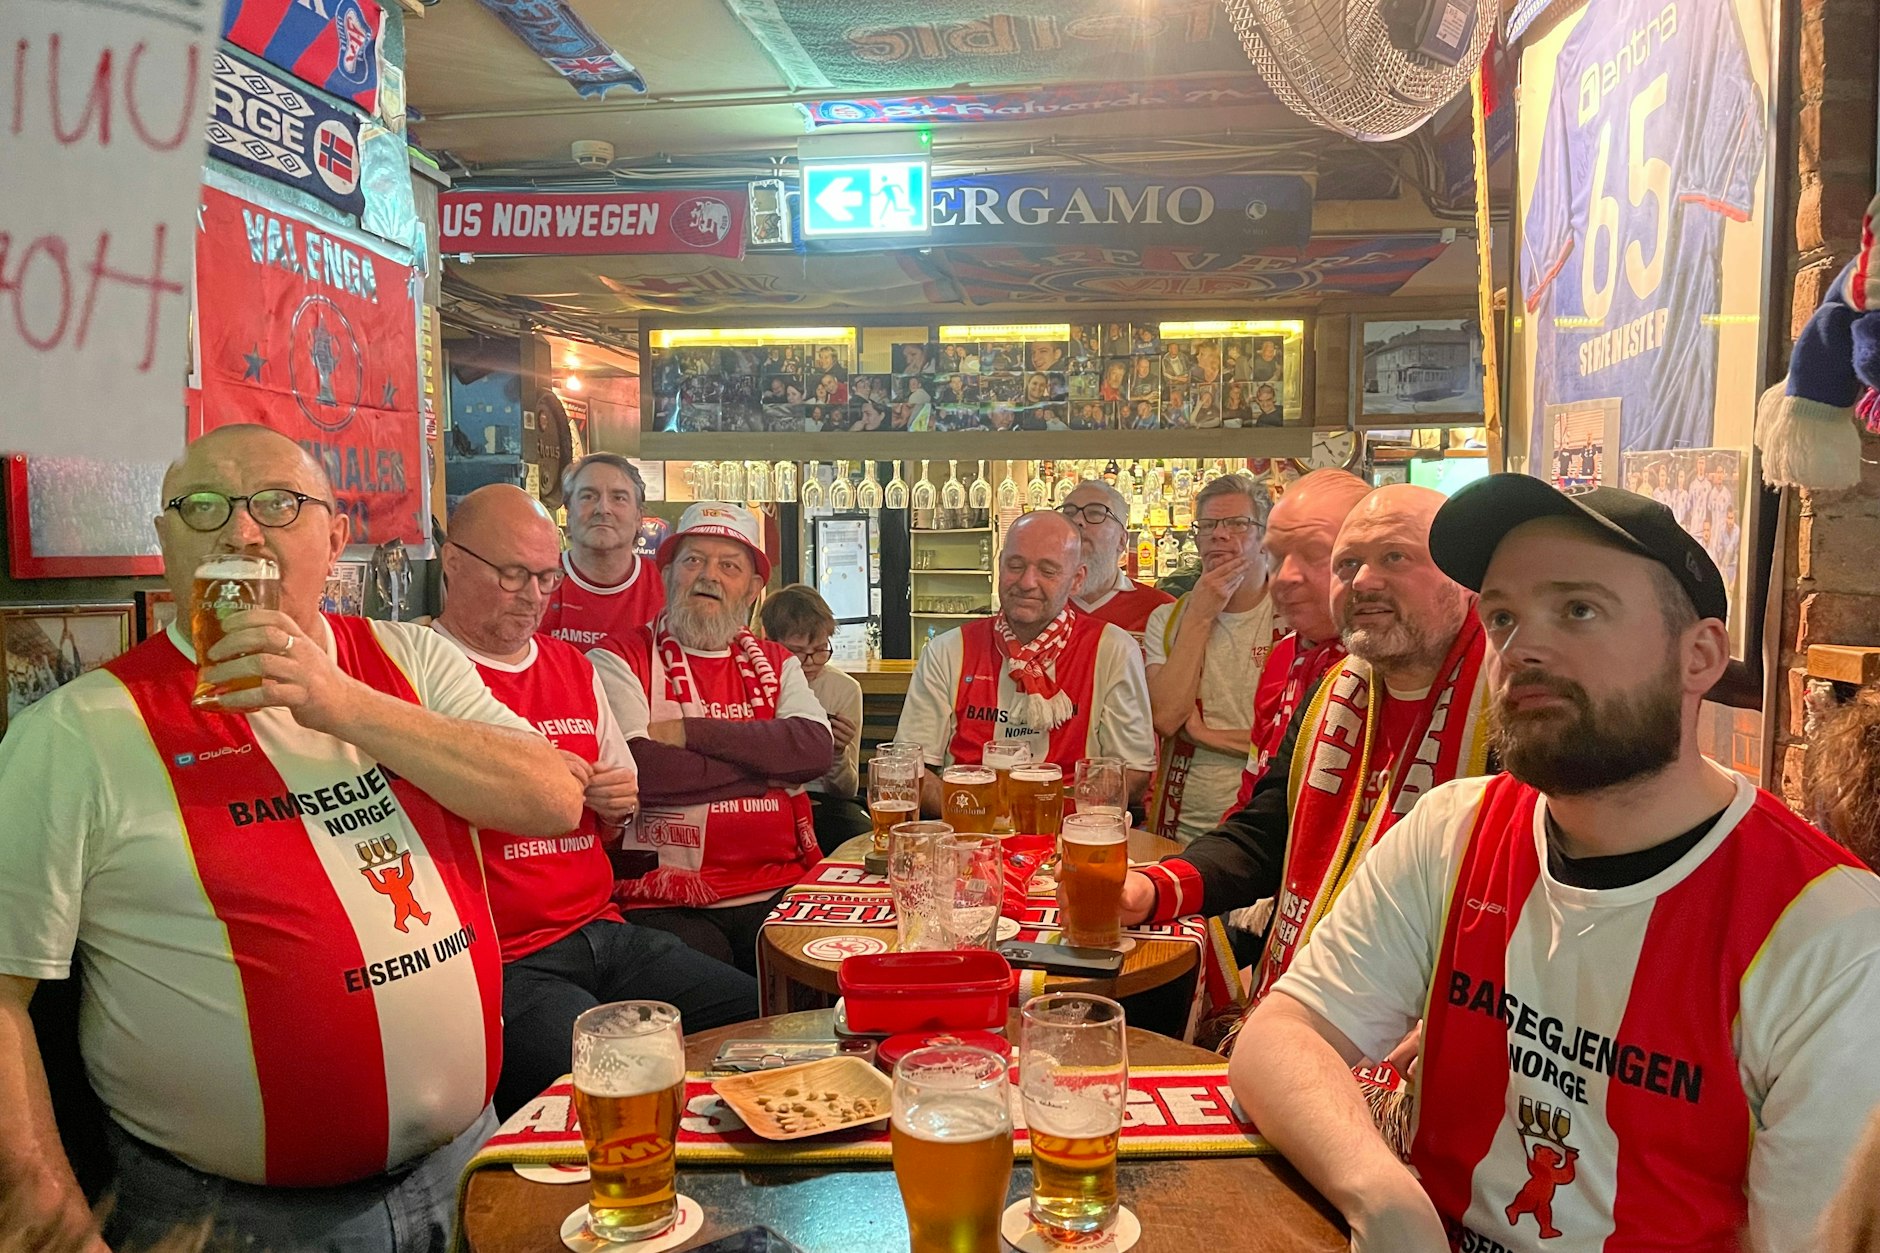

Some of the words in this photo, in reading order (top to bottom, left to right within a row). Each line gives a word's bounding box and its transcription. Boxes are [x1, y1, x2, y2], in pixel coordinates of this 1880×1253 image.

[1580, 72, 1671, 320] 65
[491, 202, 660, 238] NORWEGEN
[324, 795, 396, 838] NORGE
[710, 800, 740, 813] ERN
[743, 798, 780, 812] UNION
[503, 838, 557, 860] EISERN
[560, 834, 595, 854] UNION
[343, 945, 431, 994] EISERN
[433, 922, 478, 964] UNION
[1508, 1043, 1589, 1106] NORGE
